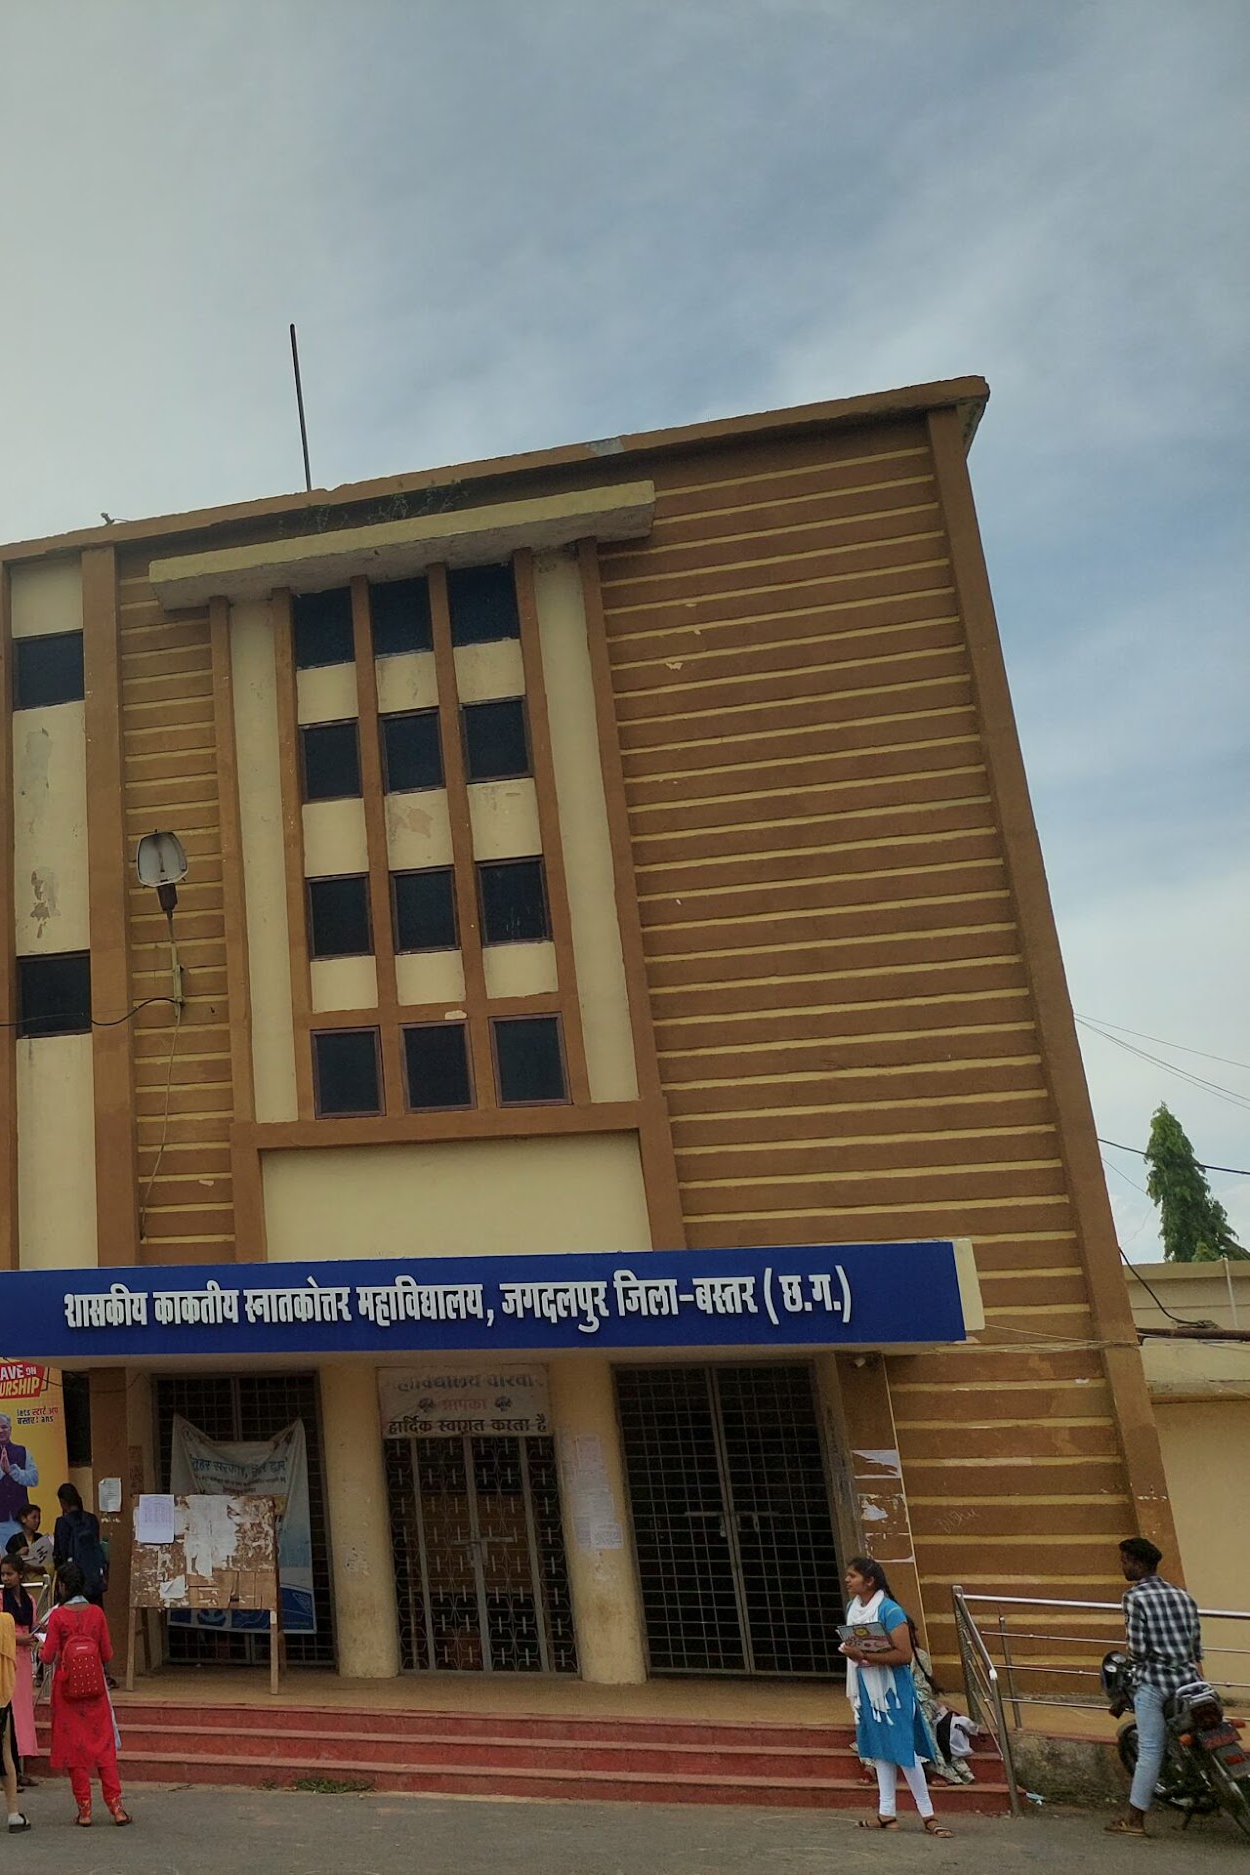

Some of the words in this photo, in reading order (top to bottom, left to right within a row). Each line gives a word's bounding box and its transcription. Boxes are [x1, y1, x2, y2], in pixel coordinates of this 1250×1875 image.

[64, 1283, 148, 1328] शासकीय
[153, 1280, 239, 1326] काकतीय
[243, 1276, 352, 1324] स्नातकोत्तर
[500, 1280, 610, 1333] जगदलपुर
[388, 1415, 433, 1435] हार्दिक
[437, 1418, 485, 1435] स्वागत
[490, 1418, 530, 1433] करता
[535, 1413, 548, 1433] है
